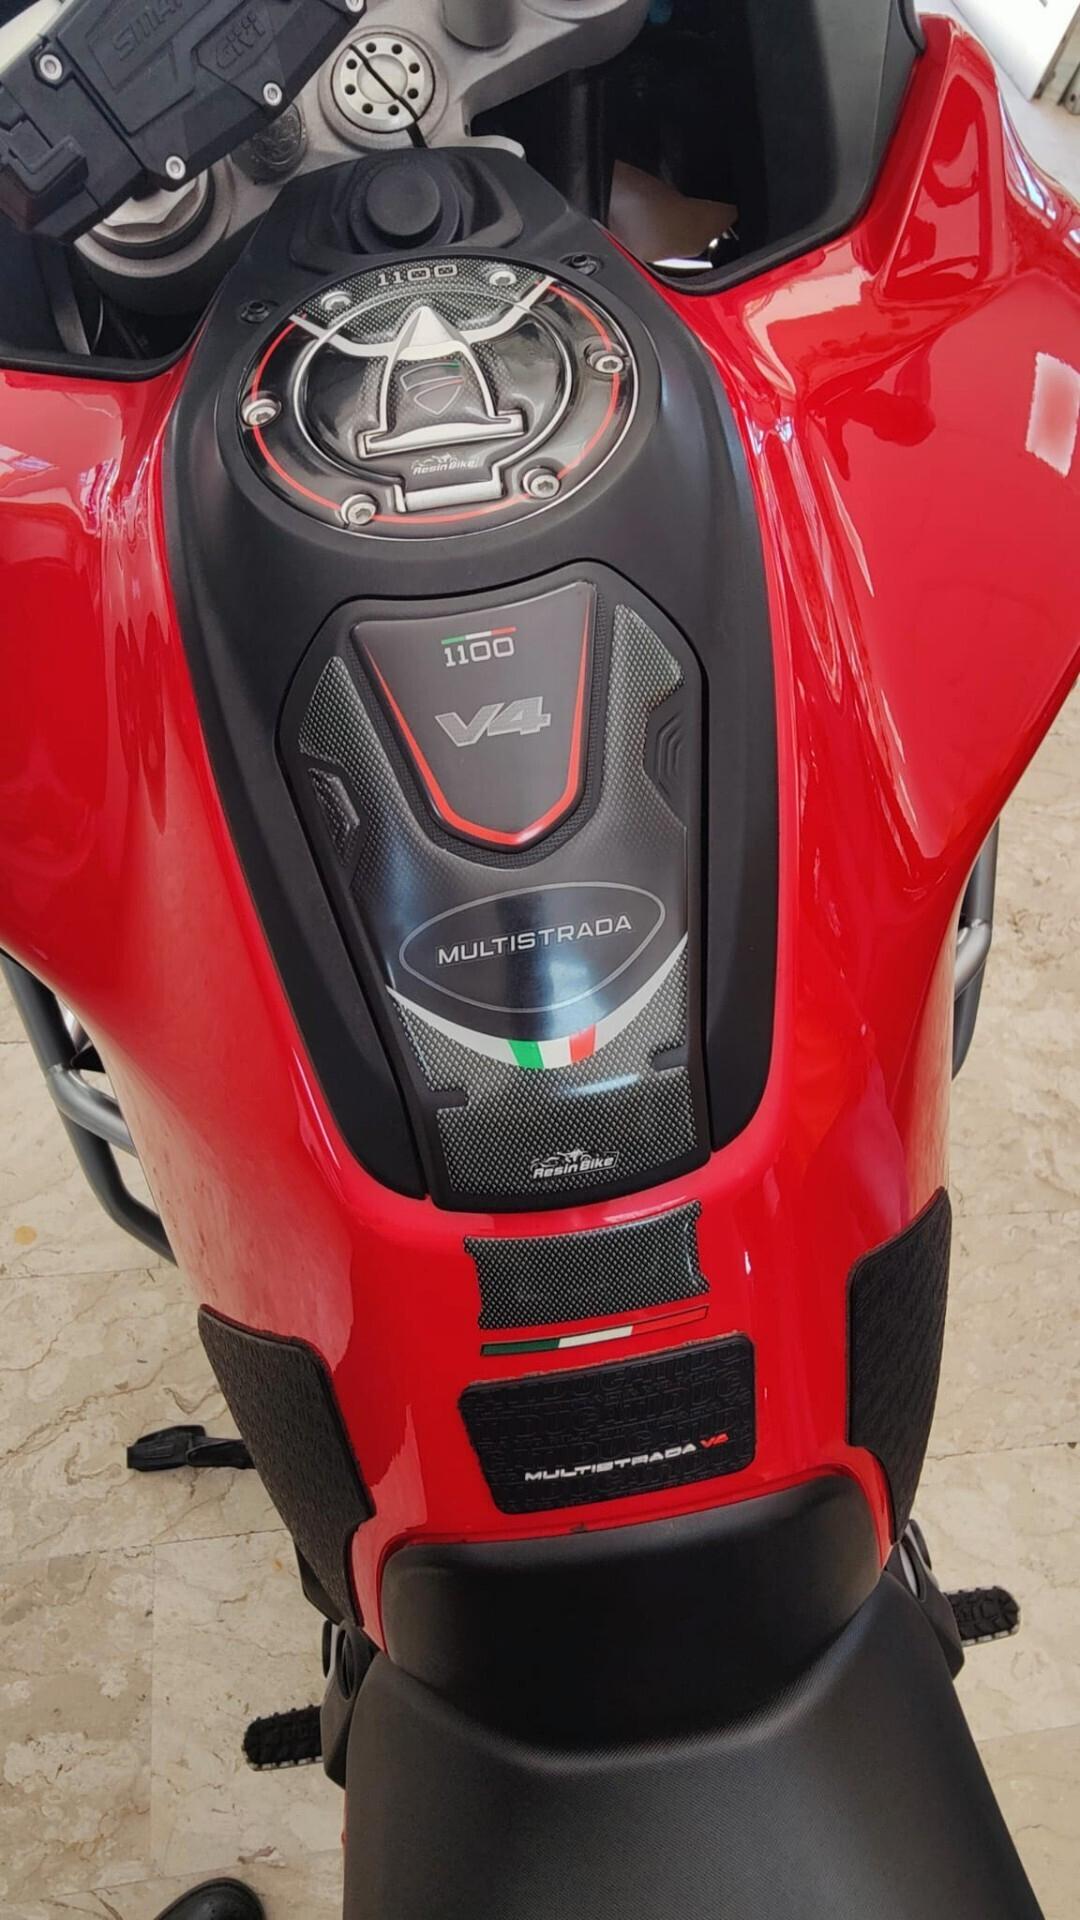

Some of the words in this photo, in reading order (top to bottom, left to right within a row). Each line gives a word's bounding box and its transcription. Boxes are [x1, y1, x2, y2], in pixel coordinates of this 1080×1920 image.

[378, 264, 458, 286] 1100
[443, 636, 515, 668] 1100
[435, 696, 551, 747] V4
[436, 914, 633, 966] MULTISTRADA
[524, 1442, 697, 1481] MULTISTRADA
[700, 1432, 729, 1449] V4
